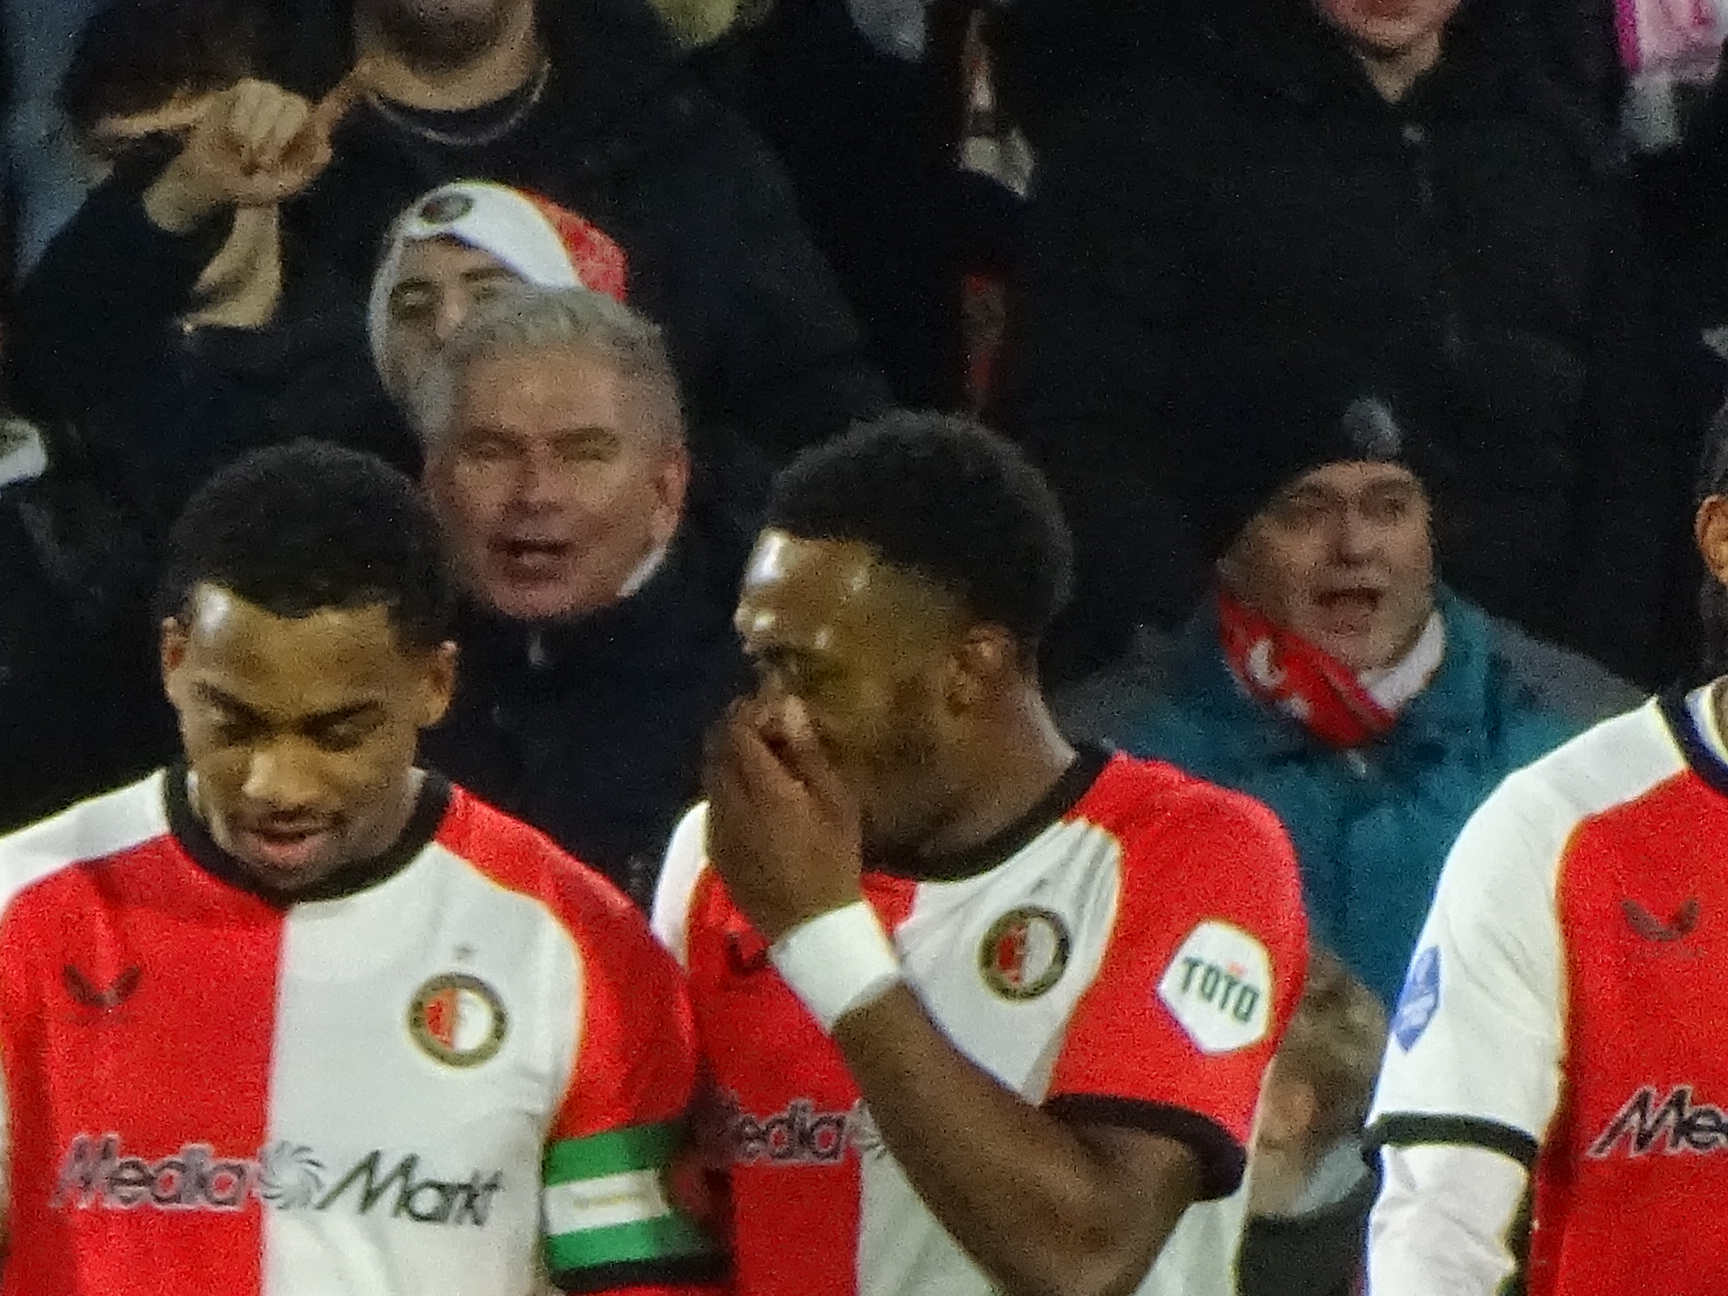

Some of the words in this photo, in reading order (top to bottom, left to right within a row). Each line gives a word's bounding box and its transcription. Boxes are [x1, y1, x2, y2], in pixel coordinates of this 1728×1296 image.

[1182, 956, 1260, 1024] TOTO
[741, 1099, 845, 1164] edia
[54, 1134, 245, 1211] Media
[315, 1149, 502, 1227] Markt
